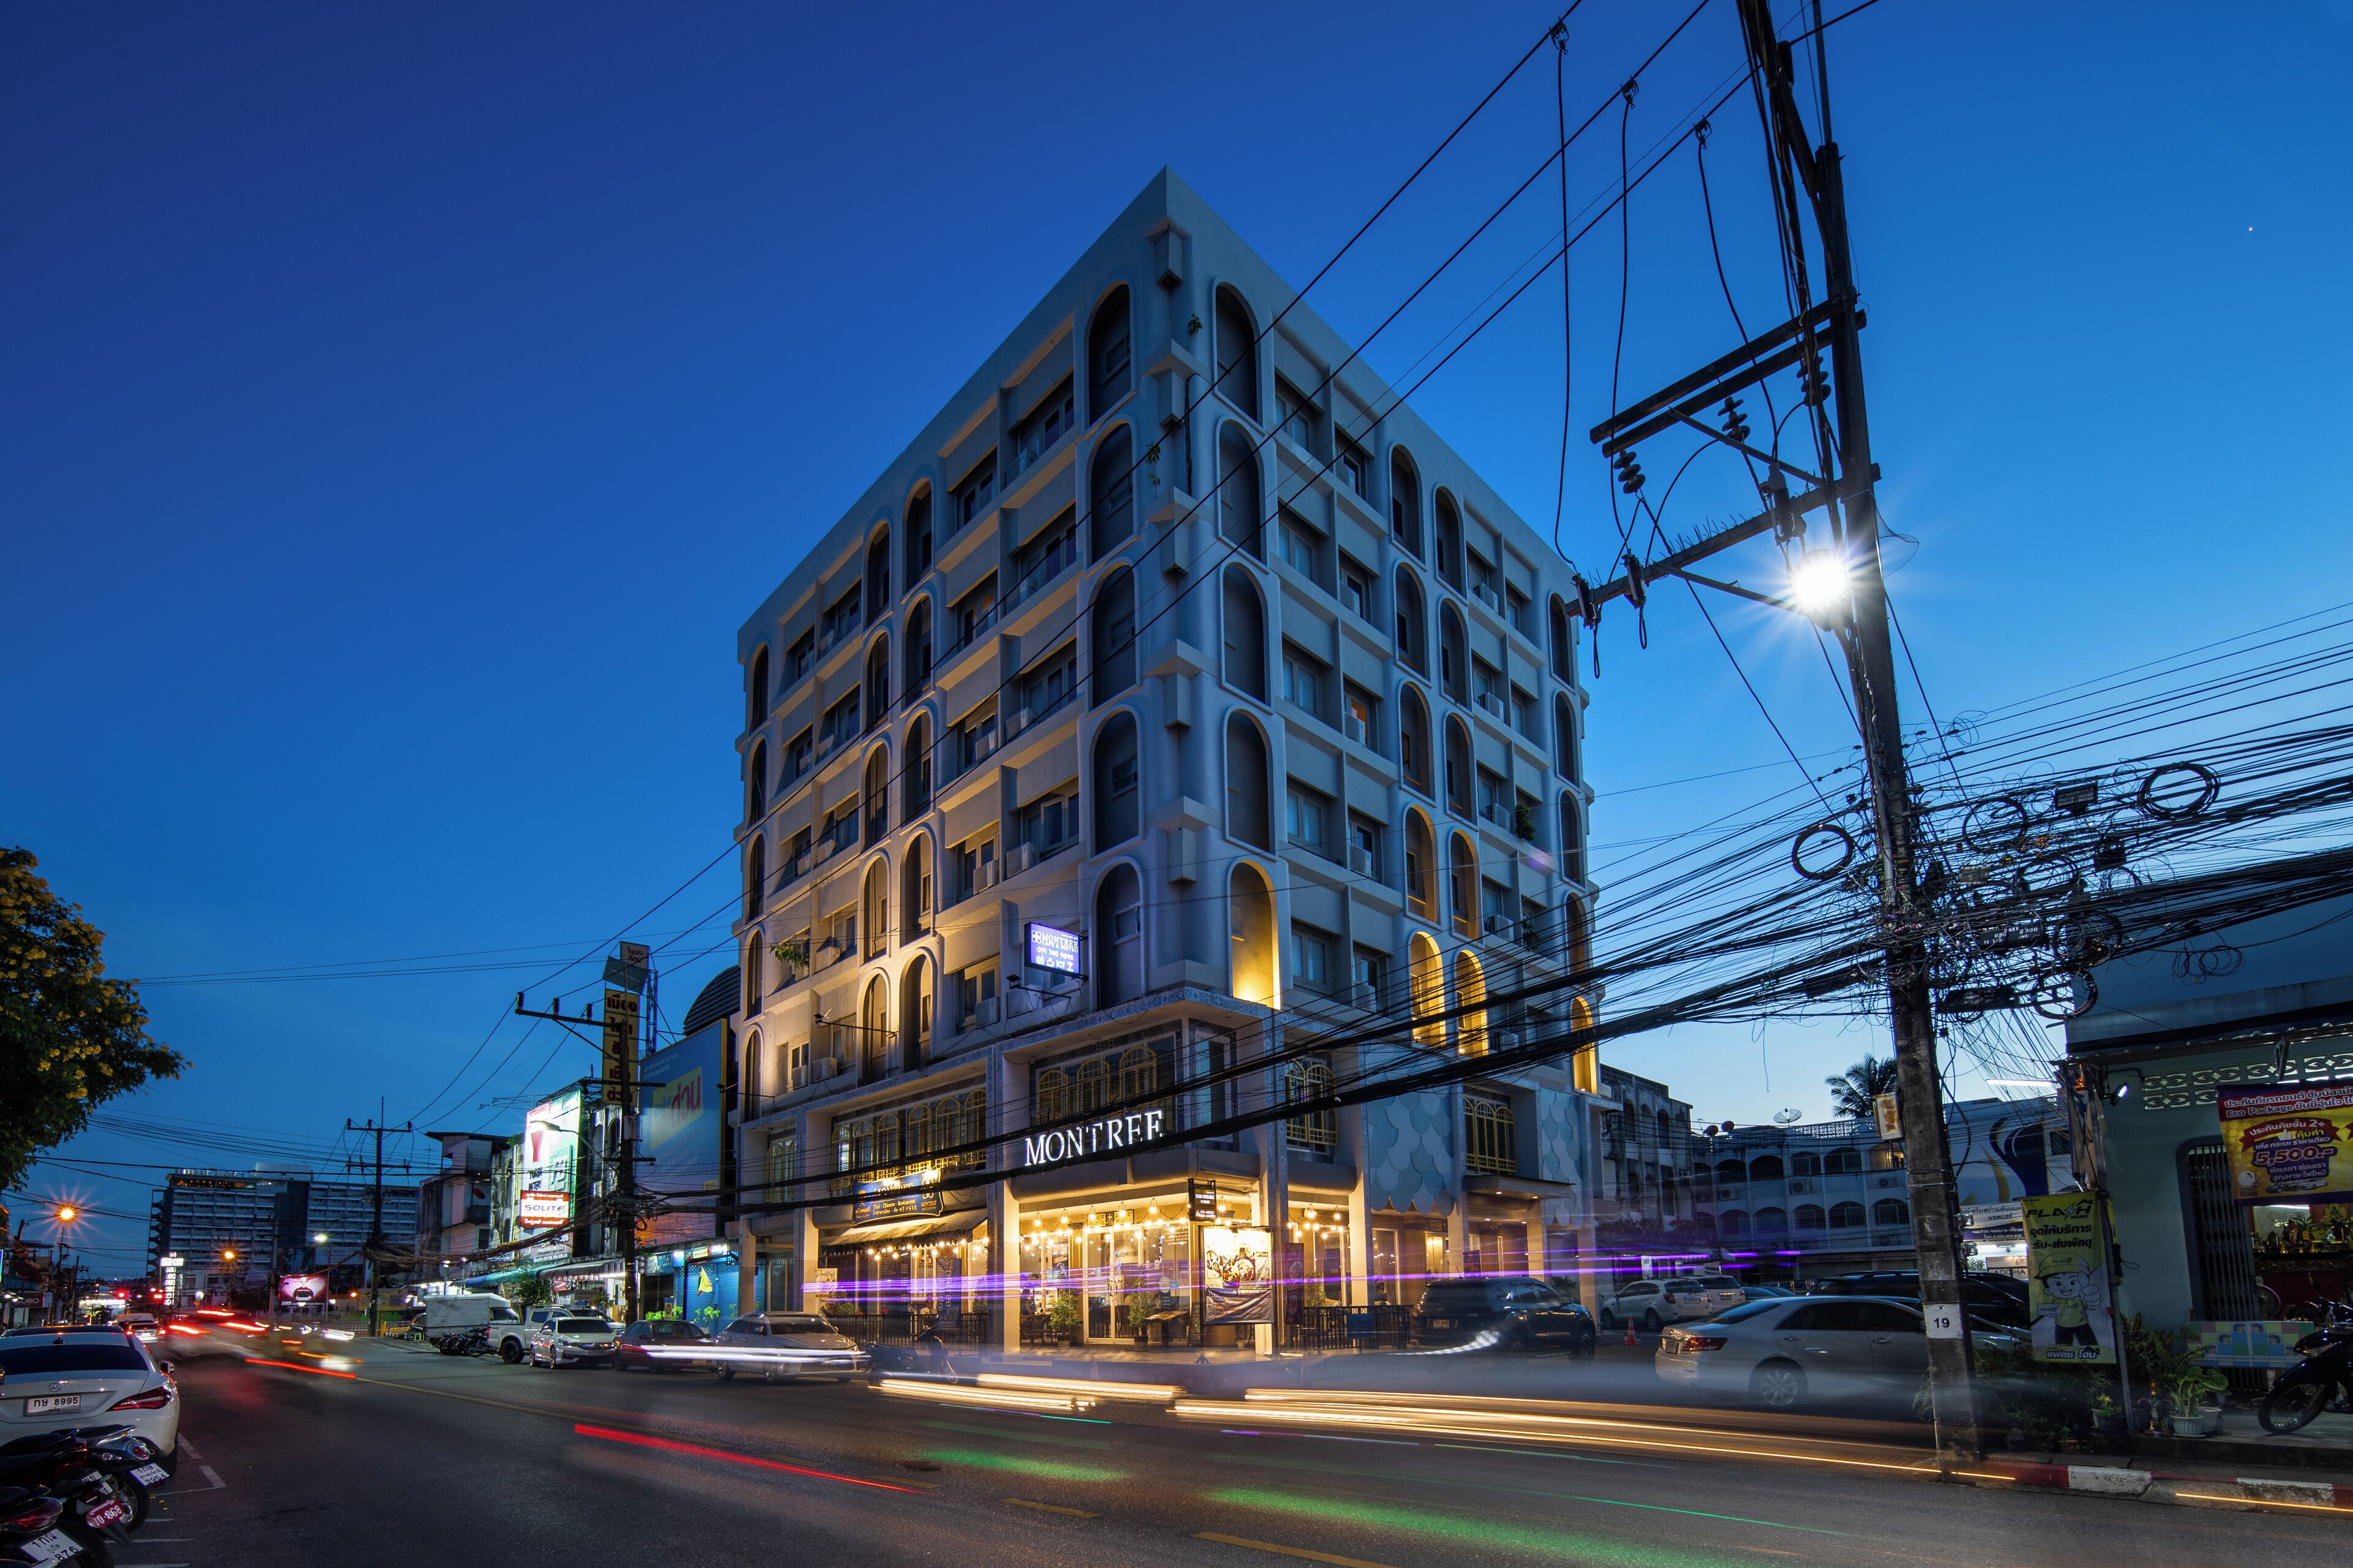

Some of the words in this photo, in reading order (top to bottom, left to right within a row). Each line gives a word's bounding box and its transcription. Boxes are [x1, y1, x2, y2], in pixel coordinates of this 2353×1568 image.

[1042, 933, 1078, 948] MONTREE
[2224, 1091, 2304, 1108] ประกันภัยรถยนต์
[2248, 1105, 2294, 1115] Package
[2249, 1119, 2306, 1136] ประกันภัยชั้น
[2309, 1119, 2325, 1127] 2+
[1025, 1110, 1163, 1166] MONTREE
[2292, 1136, 2330, 1146] ราคาเดียว
[2255, 1146, 2334, 1166] 5,500.-
[2026, 1202, 2092, 1220] FLASH
[2030, 1224, 2092, 1238] จุดให้บริการ
[2033, 1238, 2093, 1249] รับ-ส่งพัสดุ
[1933, 1317, 1950, 1329] 19
[54, 1396, 78, 1406] 8995
[145, 1474, 167, 1485] 3954
[53, 1546, 79, 1562] 876
